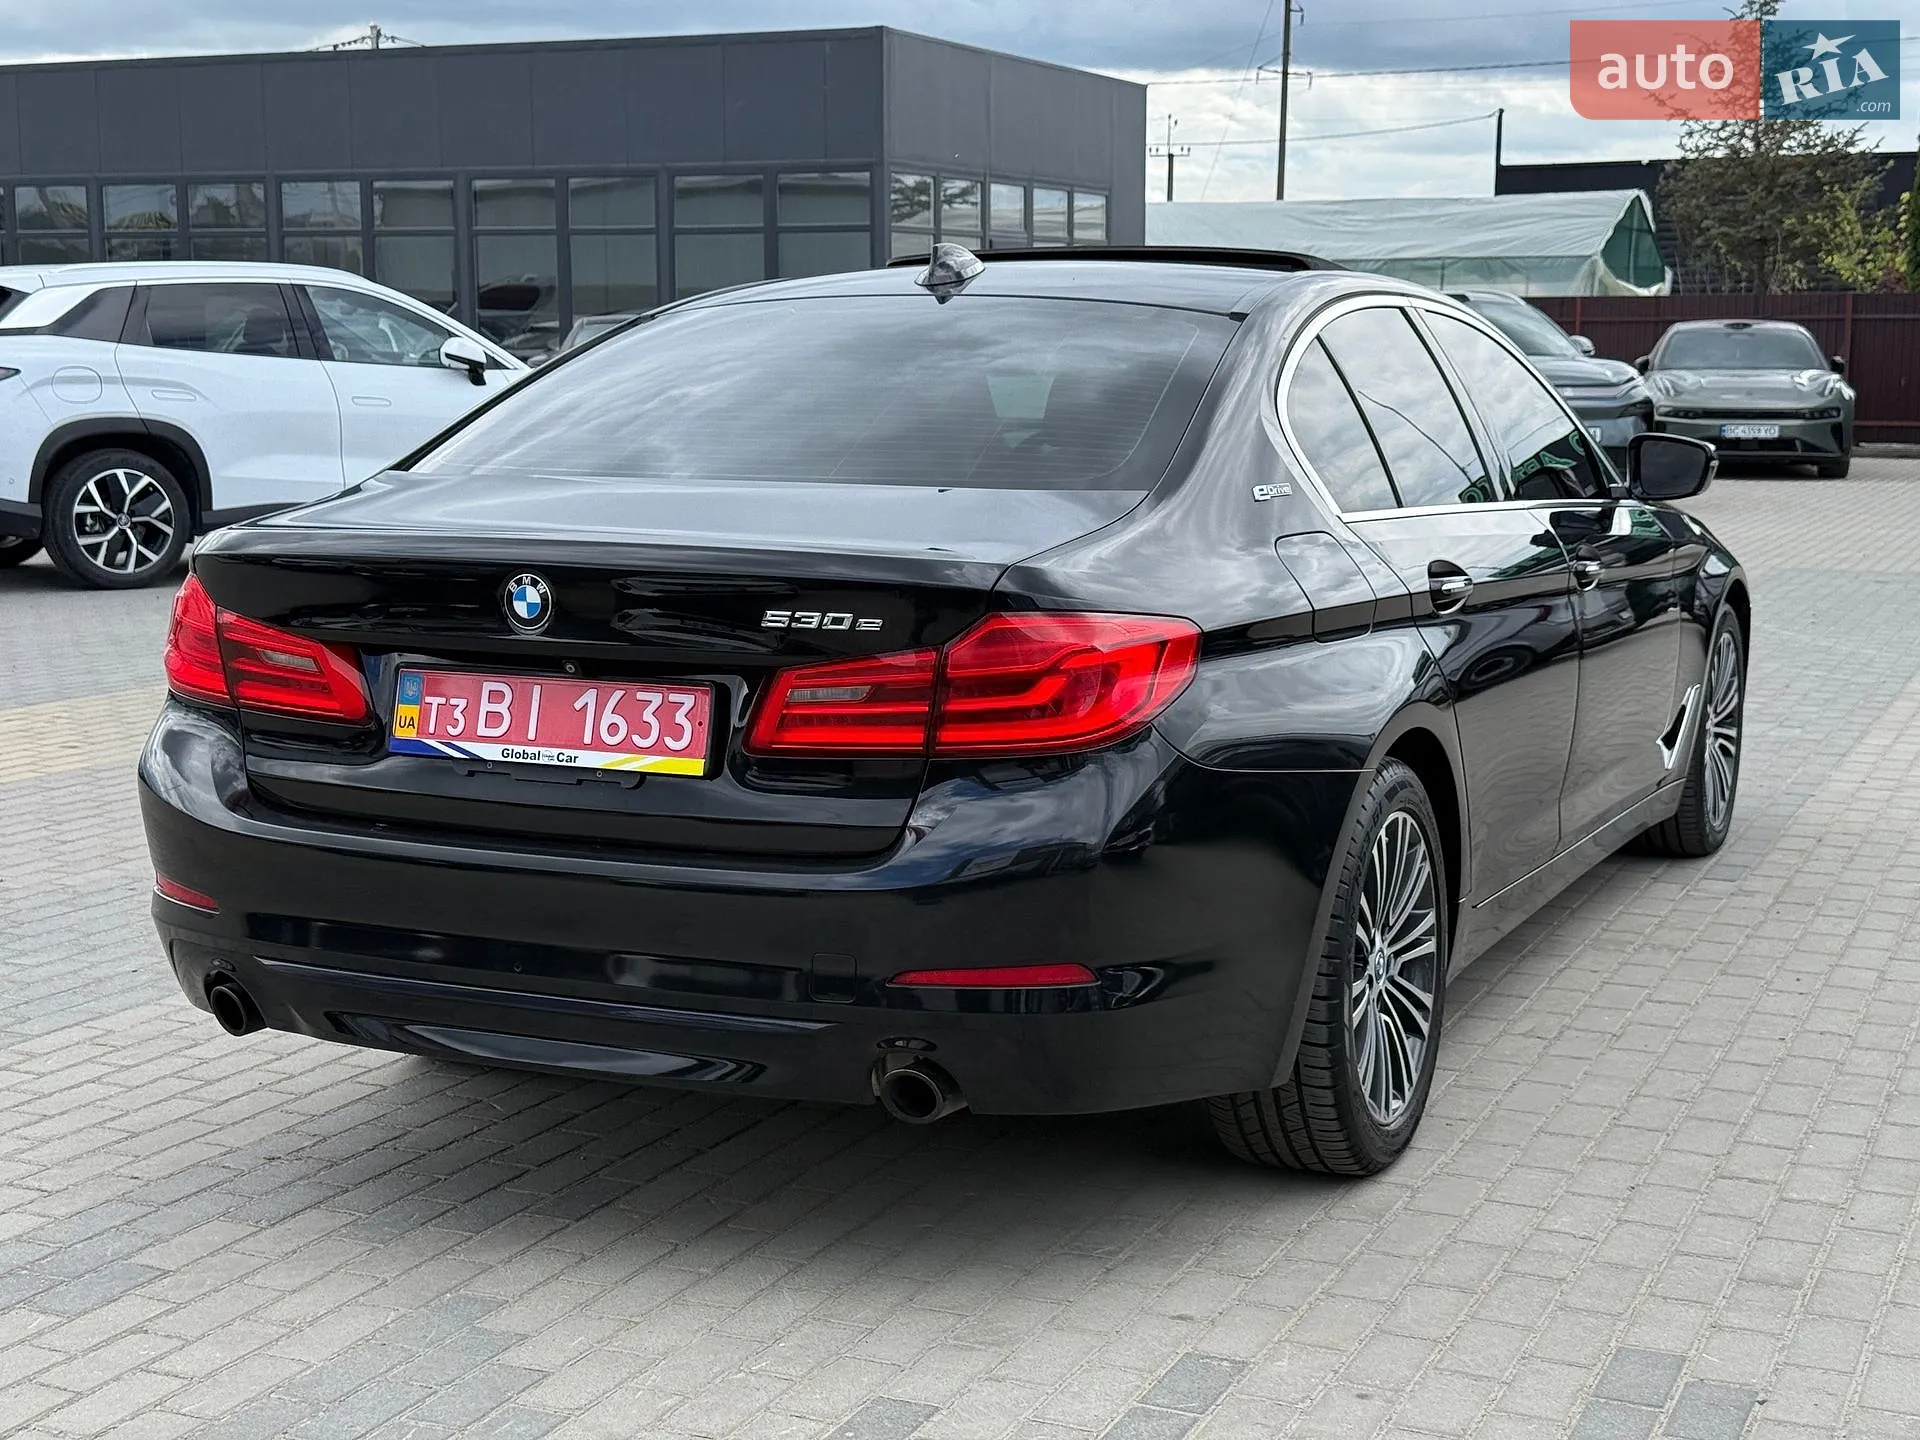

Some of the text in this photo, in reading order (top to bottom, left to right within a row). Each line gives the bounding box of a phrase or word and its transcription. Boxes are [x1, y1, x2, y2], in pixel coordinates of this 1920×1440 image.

[508, 576, 547, 594] BMW
[398, 715, 416, 730] UA
[572, 688, 696, 751] 1633
[501, 748, 541, 761] Global
[556, 752, 579, 763] Car
